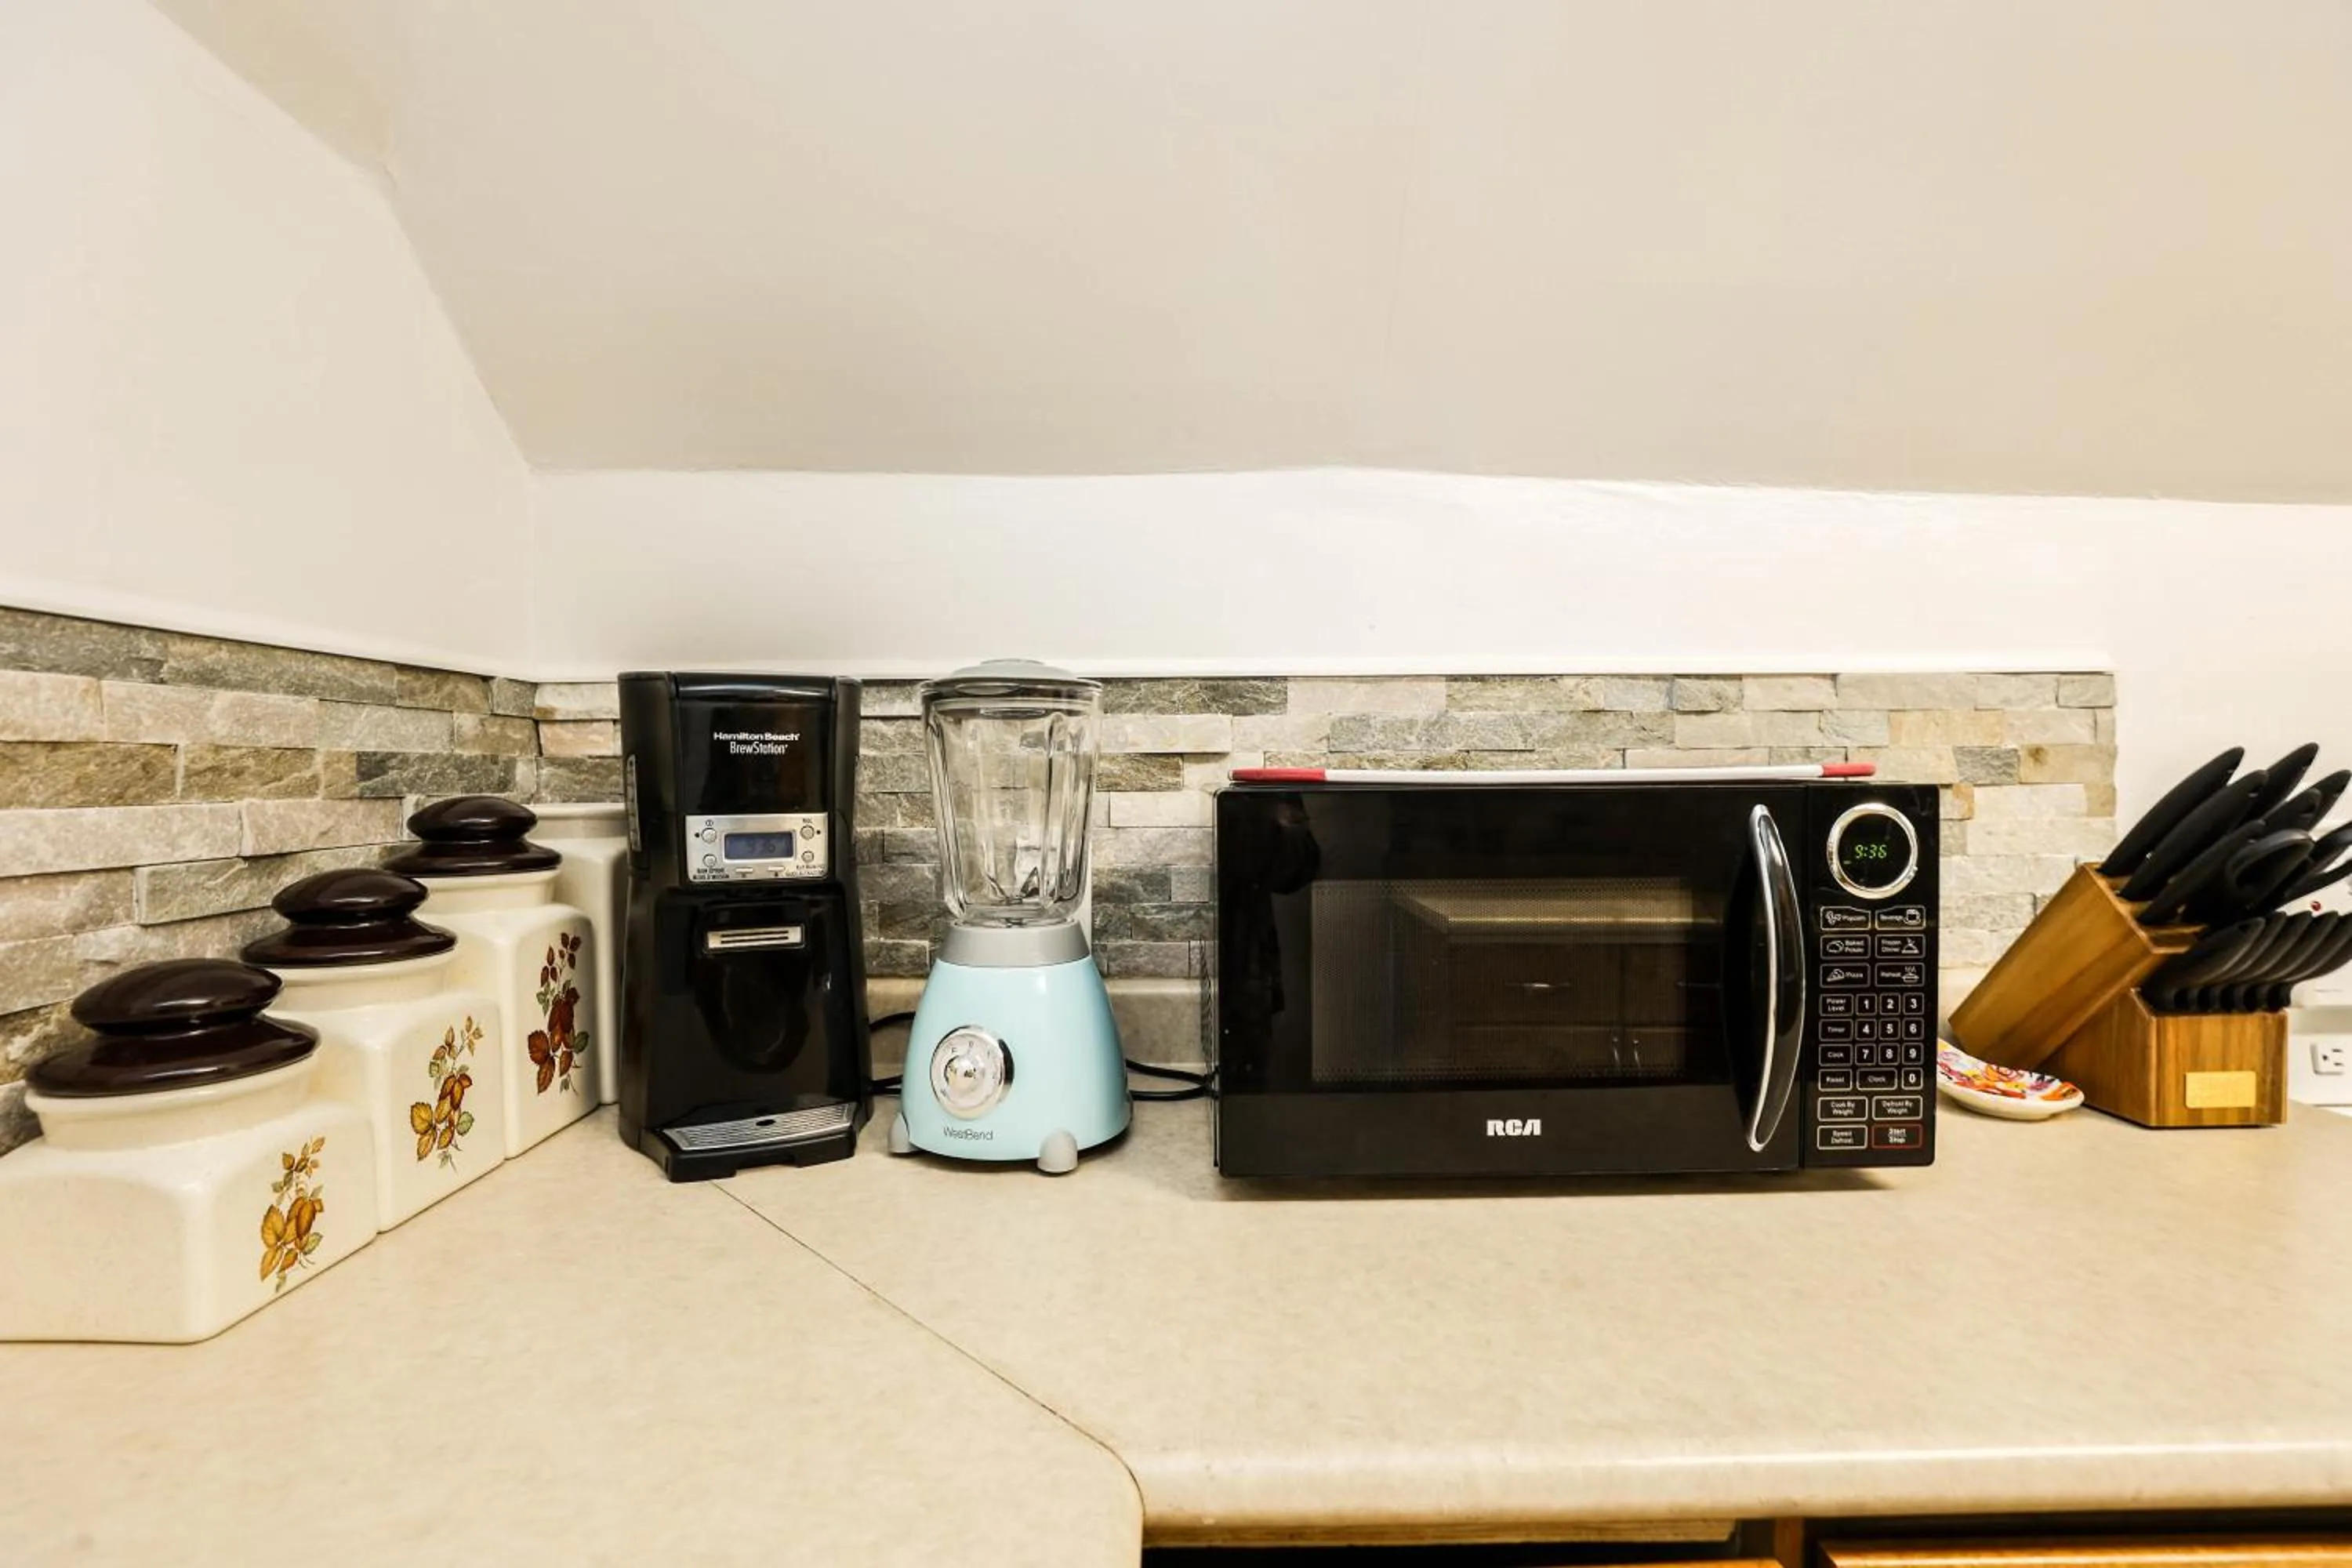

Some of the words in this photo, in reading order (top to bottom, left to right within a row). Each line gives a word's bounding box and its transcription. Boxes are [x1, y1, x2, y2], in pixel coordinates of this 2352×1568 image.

[713, 731, 764, 741] Hamilton
[730, 741, 787, 754] BrewStation
[1855, 844, 1887, 859] 9:36
[1864, 998, 1869, 1010] 1
[1886, 998, 1894, 1009] 2
[1910, 998, 1918, 1009] 3
[1862, 1023, 1870, 1034] 4
[1886, 1023, 1893, 1034] 5
[1909, 1023, 1917, 1034] 6
[1862, 1048, 1869, 1059] 7
[1886, 1048, 1893, 1059] 8
[1909, 1048, 1917, 1059] 9
[1909, 1073, 1917, 1083] 0
[1486, 1119, 1541, 1136] RCA
